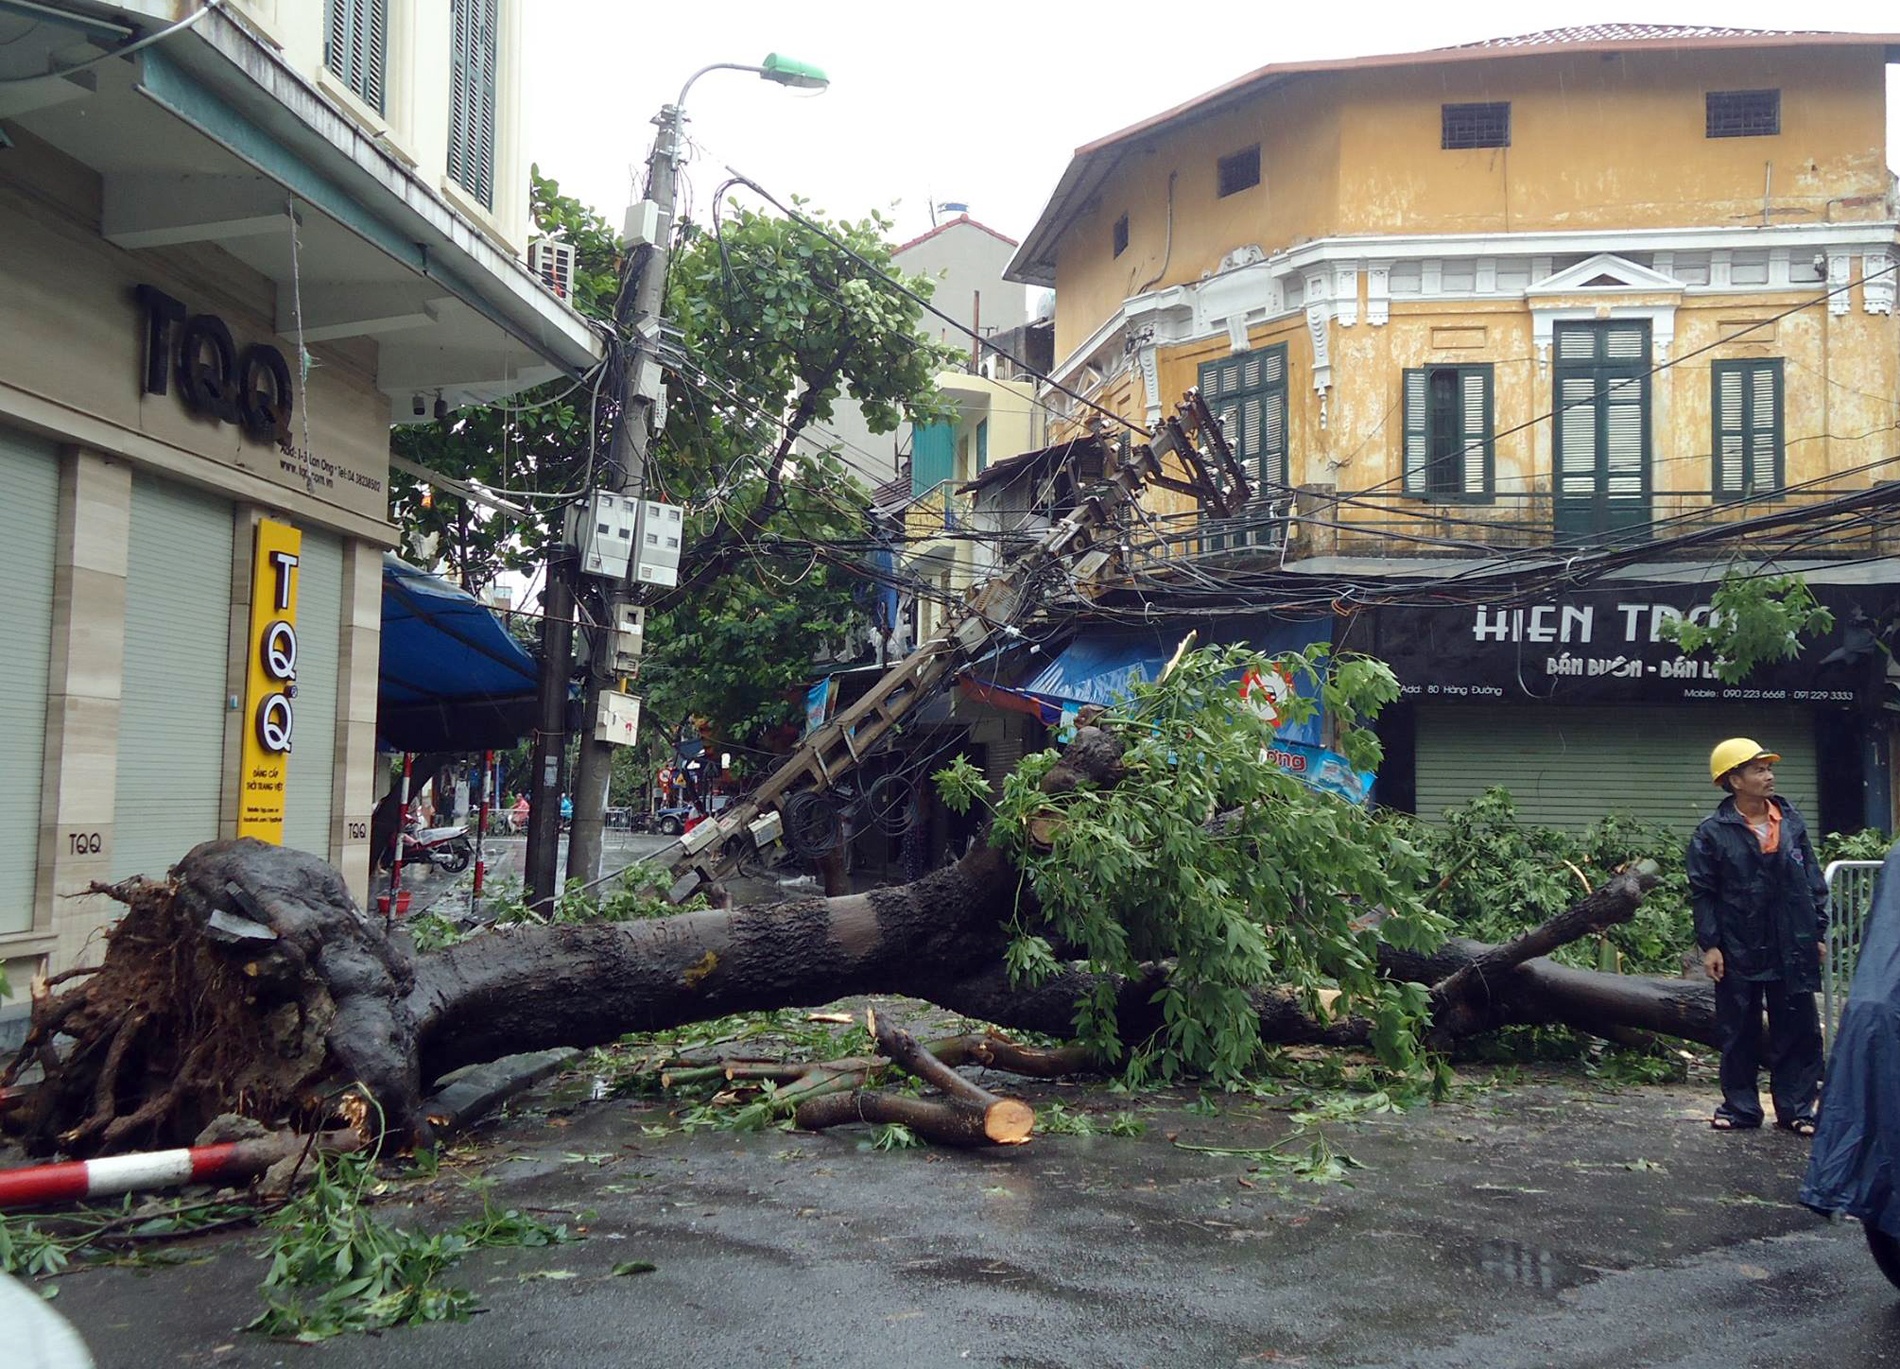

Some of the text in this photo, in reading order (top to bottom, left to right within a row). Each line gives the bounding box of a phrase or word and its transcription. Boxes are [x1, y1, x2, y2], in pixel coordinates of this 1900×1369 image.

[136, 284, 293, 447] TQQ
[1546, 652, 1583, 676] BÁN
[1401, 684, 1422, 694] Add:
[1427, 685, 1440, 694] 80
[1684, 689, 1719, 698] Mobile:
[1723, 689, 1741, 698] 090
[1743, 690, 1760, 698] 223
[1762, 690, 1786, 699] 6668
[1810, 691, 1828, 700] 229
[1830, 691, 1853, 700] 3333
[348, 822, 367, 839] TQQ
[69, 832, 102, 856] TQQ
